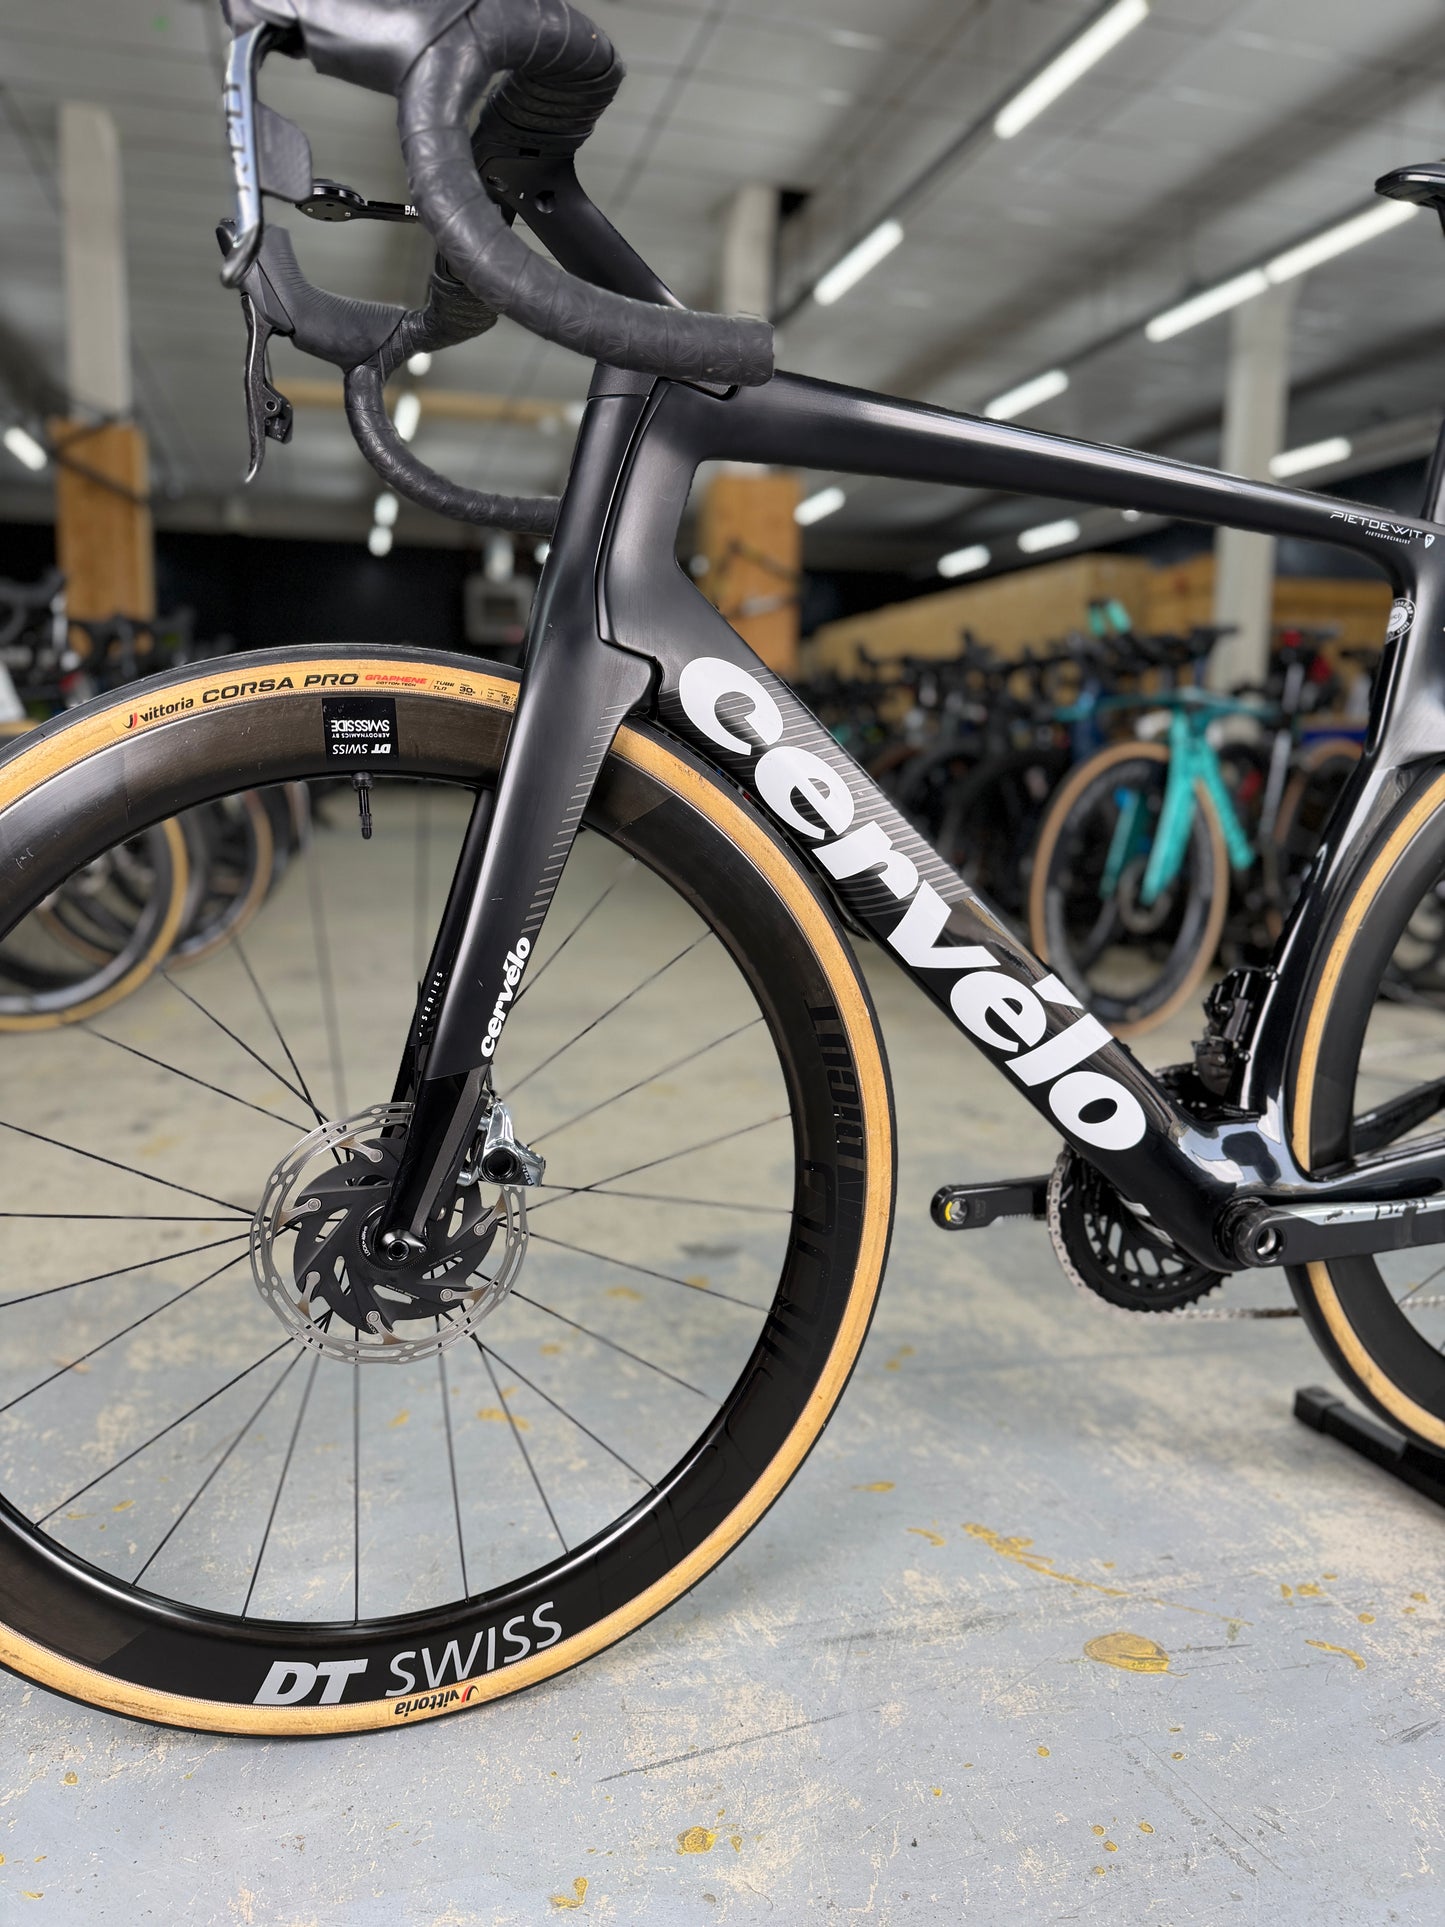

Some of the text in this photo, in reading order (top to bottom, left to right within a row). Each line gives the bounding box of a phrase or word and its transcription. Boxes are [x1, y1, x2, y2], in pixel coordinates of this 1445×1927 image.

[140, 673, 359, 721] vittoria CORSA PRO
[365, 674, 428, 685] GRAPHENE
[332, 743, 391, 755] DT SWISS
[678, 656, 1147, 1151] cervélo
[480, 936, 531, 1058] cervélo
[252, 1601, 562, 1706] DT SWISS
[394, 1689, 460, 1718] vittoria
